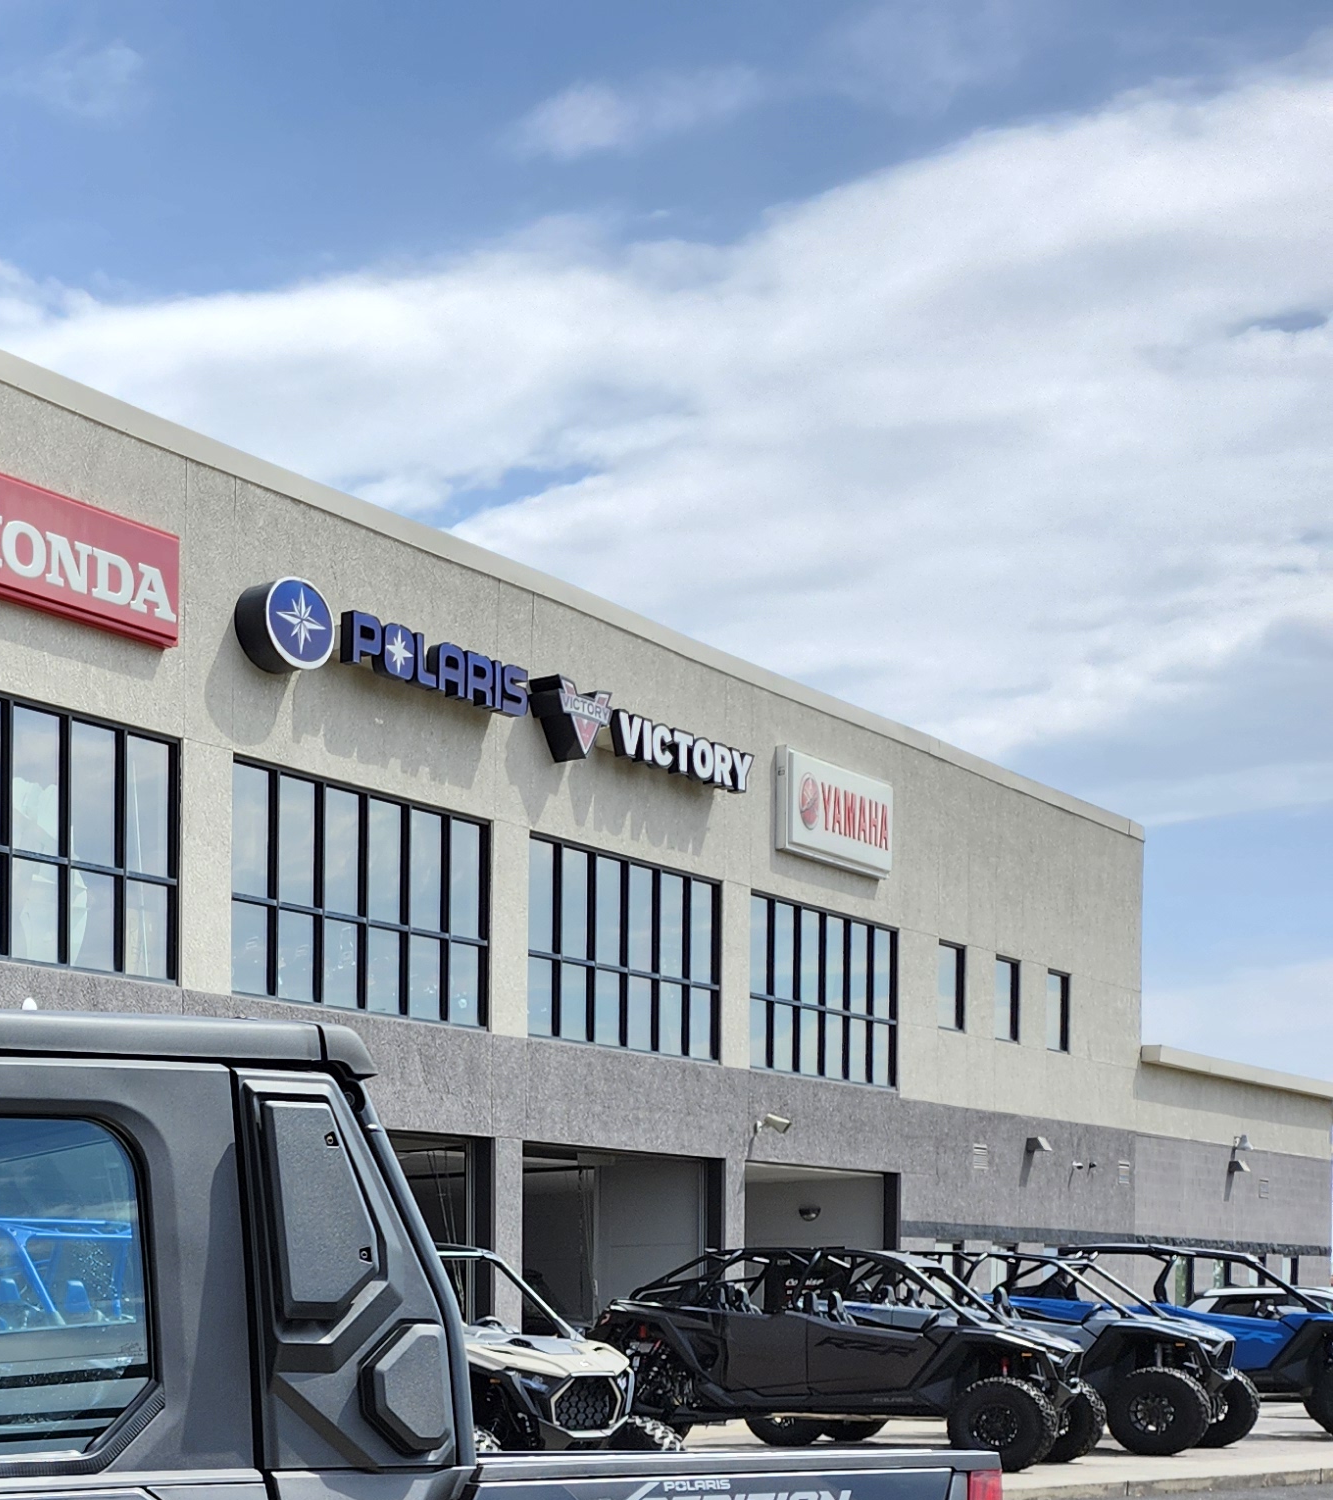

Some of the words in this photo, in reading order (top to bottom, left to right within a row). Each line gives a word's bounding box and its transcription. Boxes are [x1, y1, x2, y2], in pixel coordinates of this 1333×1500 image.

[340, 610, 529, 718] POLARIS
[561, 694, 611, 723] VICTORY
[614, 709, 754, 793] VICTORY
[821, 781, 889, 852] YAMAHA
[663, 1479, 731, 1492] POLARIS
